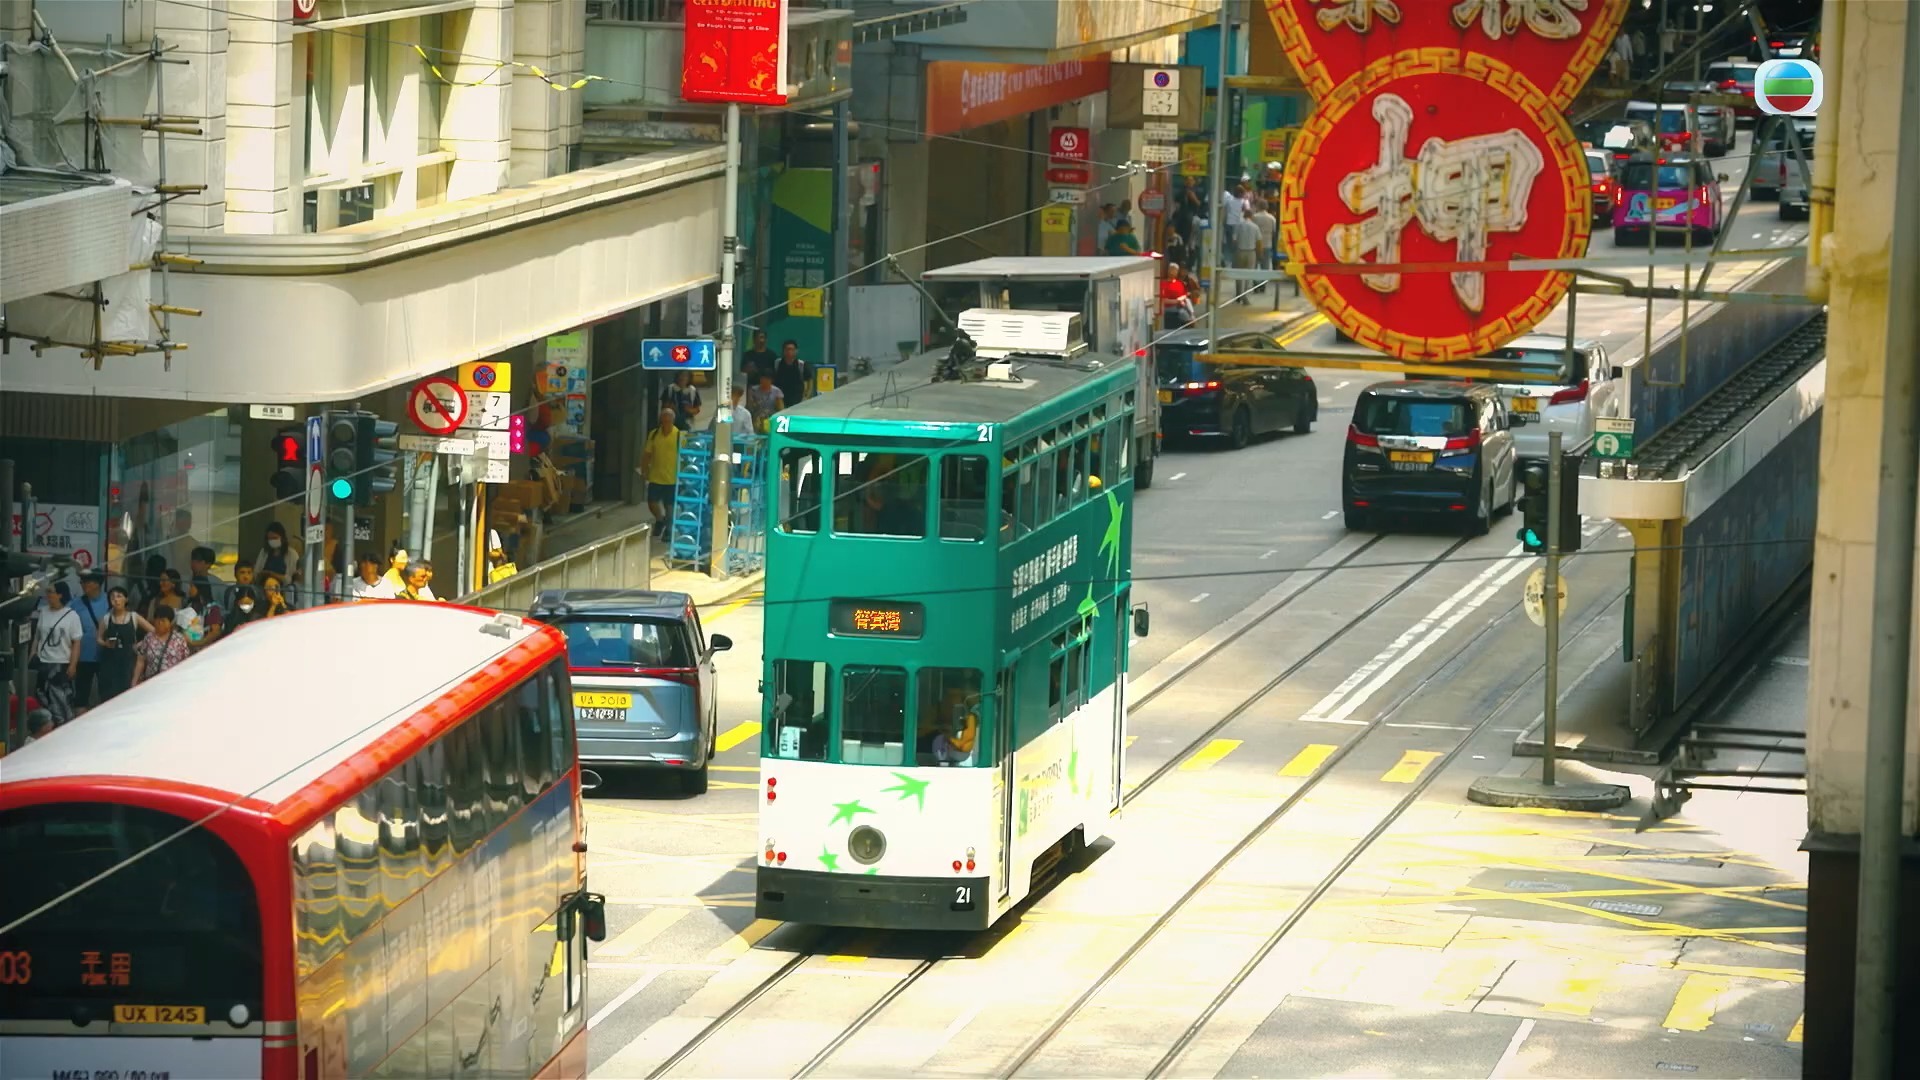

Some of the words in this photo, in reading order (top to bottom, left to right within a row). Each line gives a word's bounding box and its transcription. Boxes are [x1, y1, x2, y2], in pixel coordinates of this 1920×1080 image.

[1326, 93, 1544, 312] 押
[492, 395, 501, 407] 7
[492, 415, 501, 427] 7
[776, 415, 790, 433] 21
[976, 424, 993, 442] 21
[854, 609, 901, 631] 筲箕灣
[955, 886, 971, 904] 21
[122, 1008, 147, 1022] UX
[155, 1008, 198, 1022] 1245
